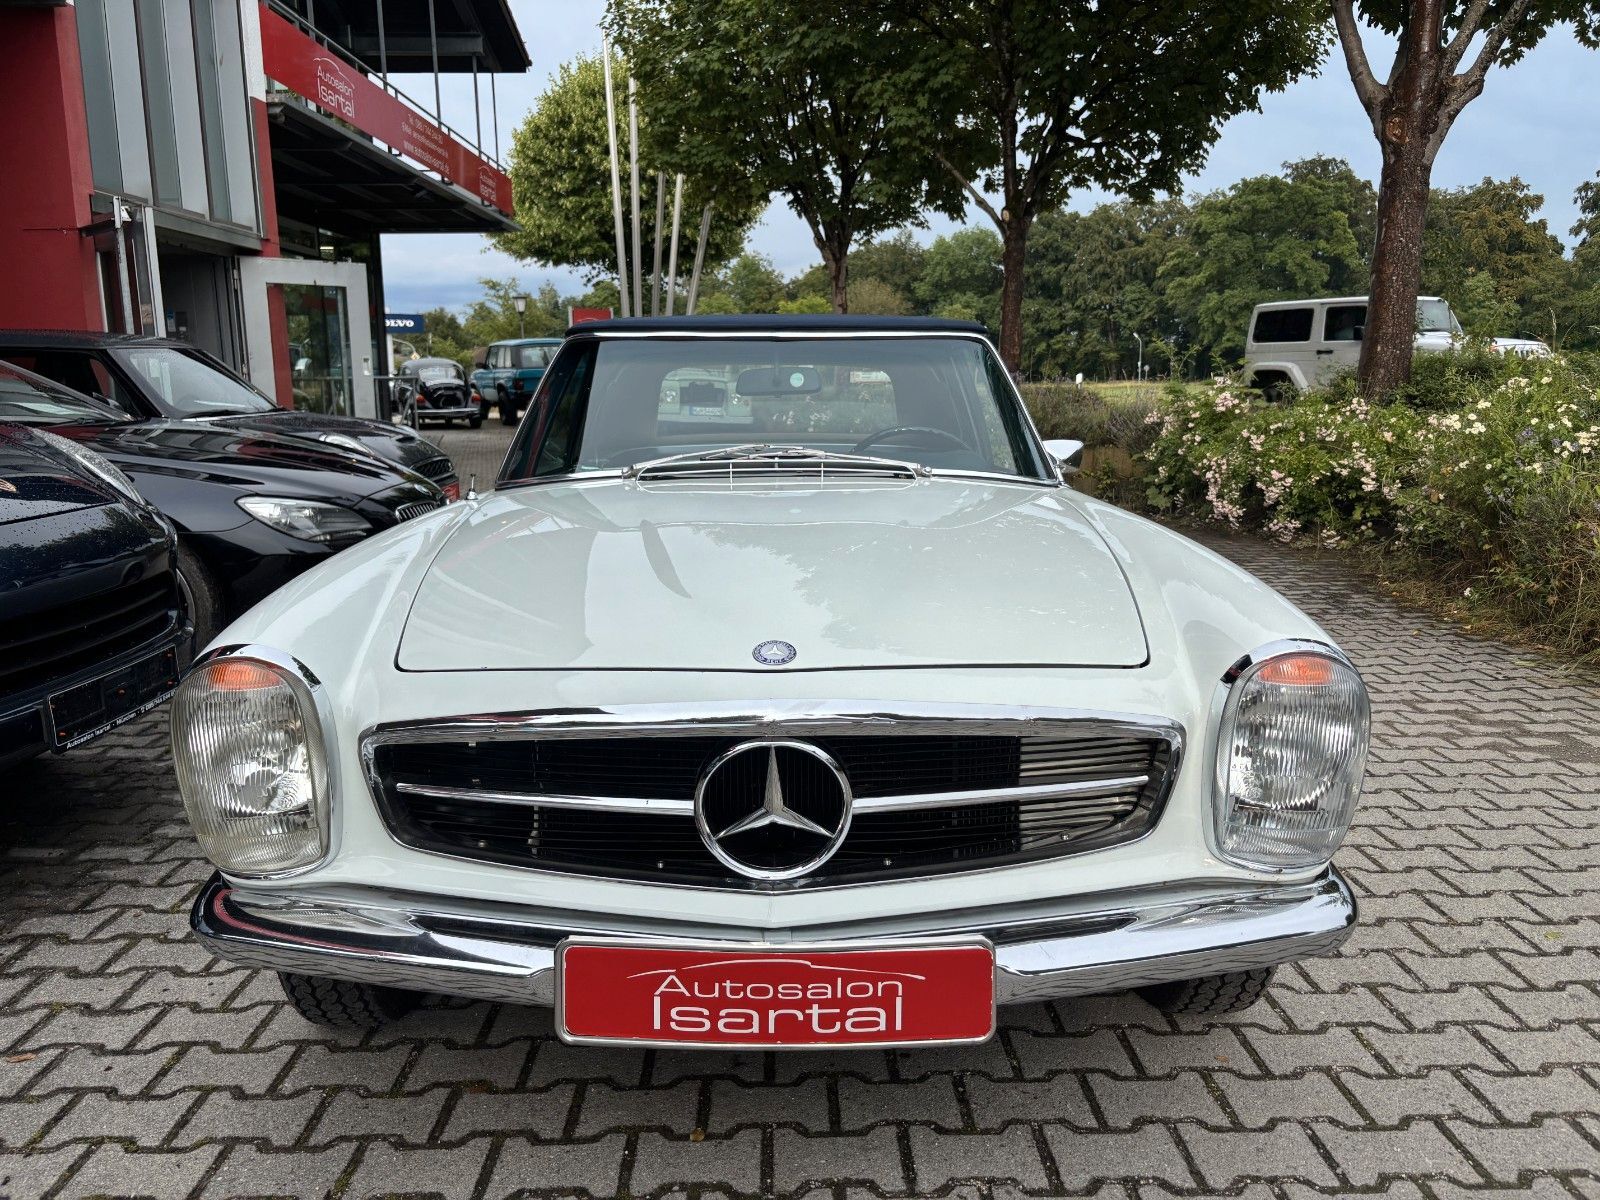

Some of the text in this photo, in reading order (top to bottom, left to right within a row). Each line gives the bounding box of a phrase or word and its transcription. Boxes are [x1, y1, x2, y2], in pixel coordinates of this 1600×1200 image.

[317, 65, 354, 98] Autosalon
[317, 77, 355, 119] Isartal
[66, 733, 95, 749] Autosalon
[653, 974, 904, 1000] Autosalon
[652, 995, 904, 1035] Isartal
